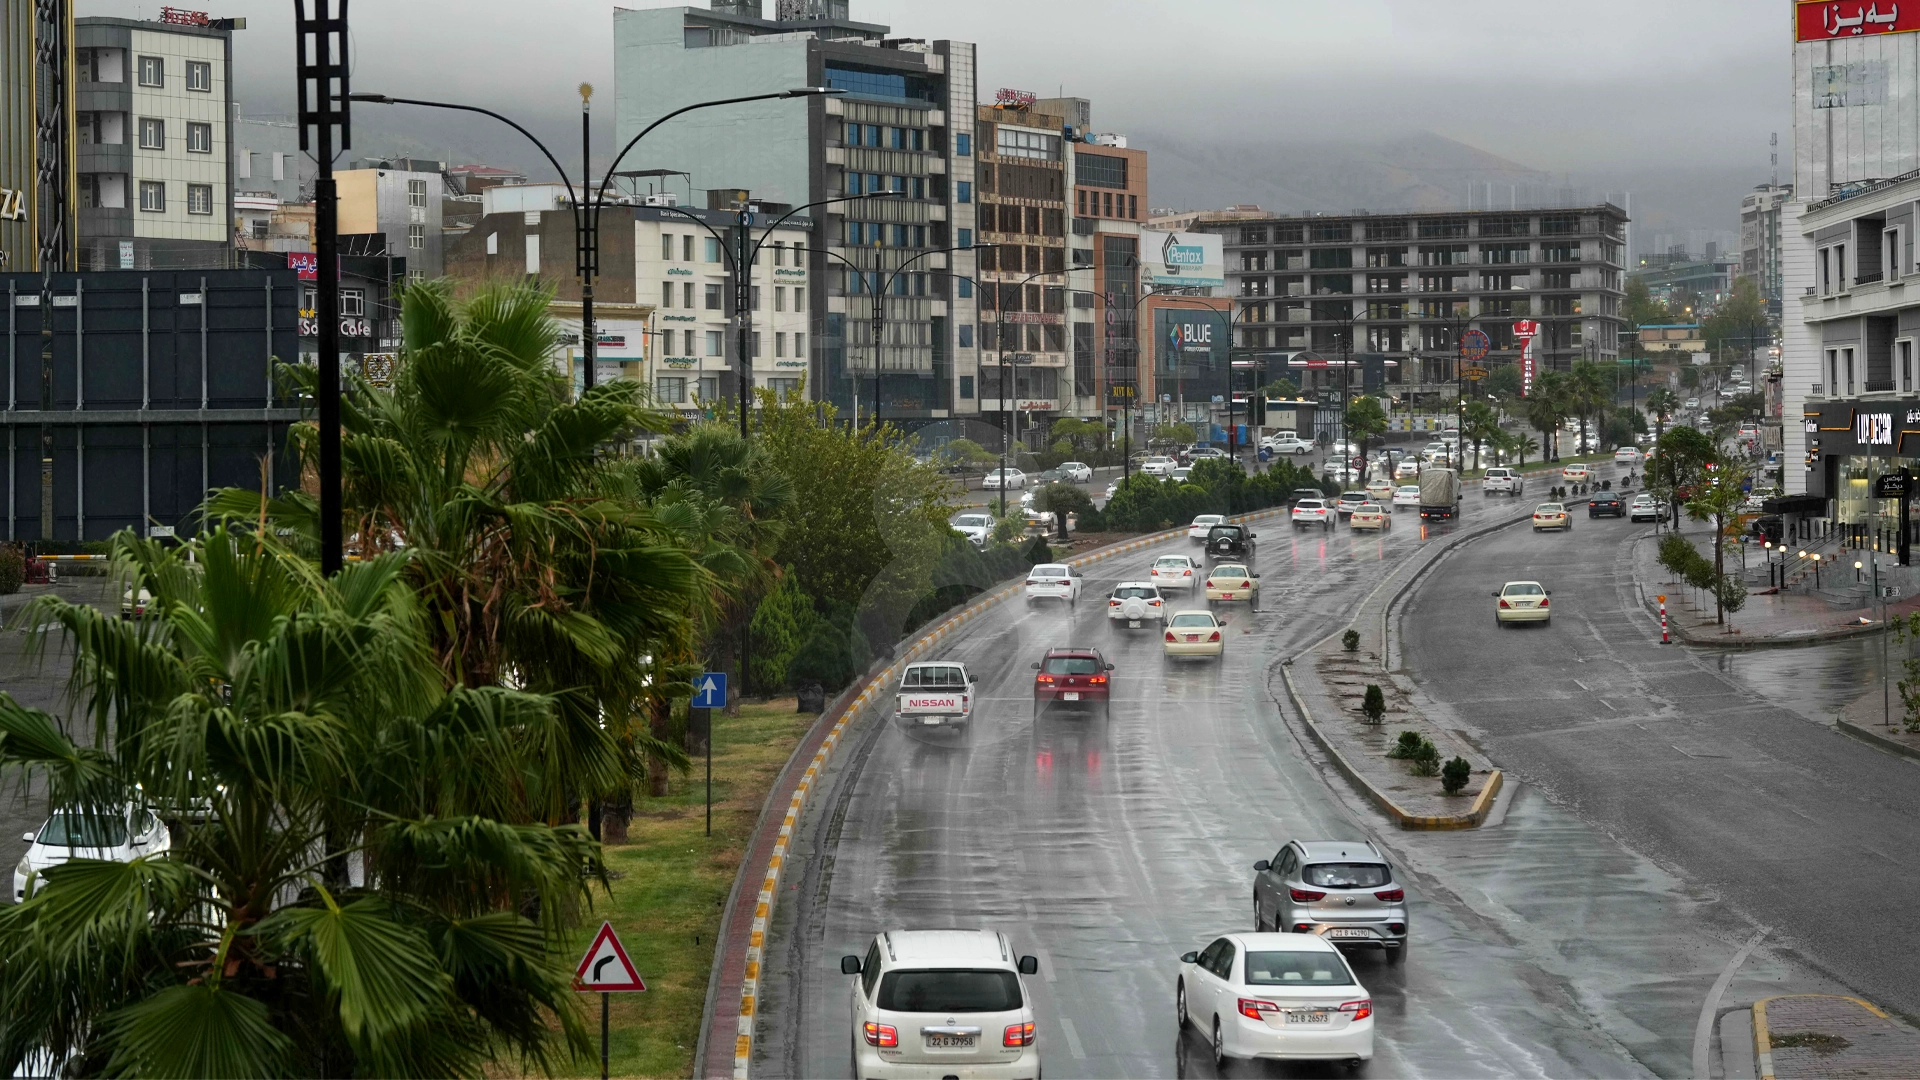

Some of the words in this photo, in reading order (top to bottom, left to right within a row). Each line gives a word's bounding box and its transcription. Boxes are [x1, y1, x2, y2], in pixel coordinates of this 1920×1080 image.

[1171, 247, 1202, 263] Pentax
[340, 320, 371, 336] Cafe
[1184, 323, 1211, 342] BLUE
[1107, 291, 1115, 385] HOTEL
[1857, 414, 1869, 444] LUX
[1871, 413, 1892, 444] DECOR
[909, 699, 954, 707] NISSAN
[932, 1037, 940, 1046] 22
[943, 1037, 949, 1046] G
[951, 1037, 973, 1046] 37958
